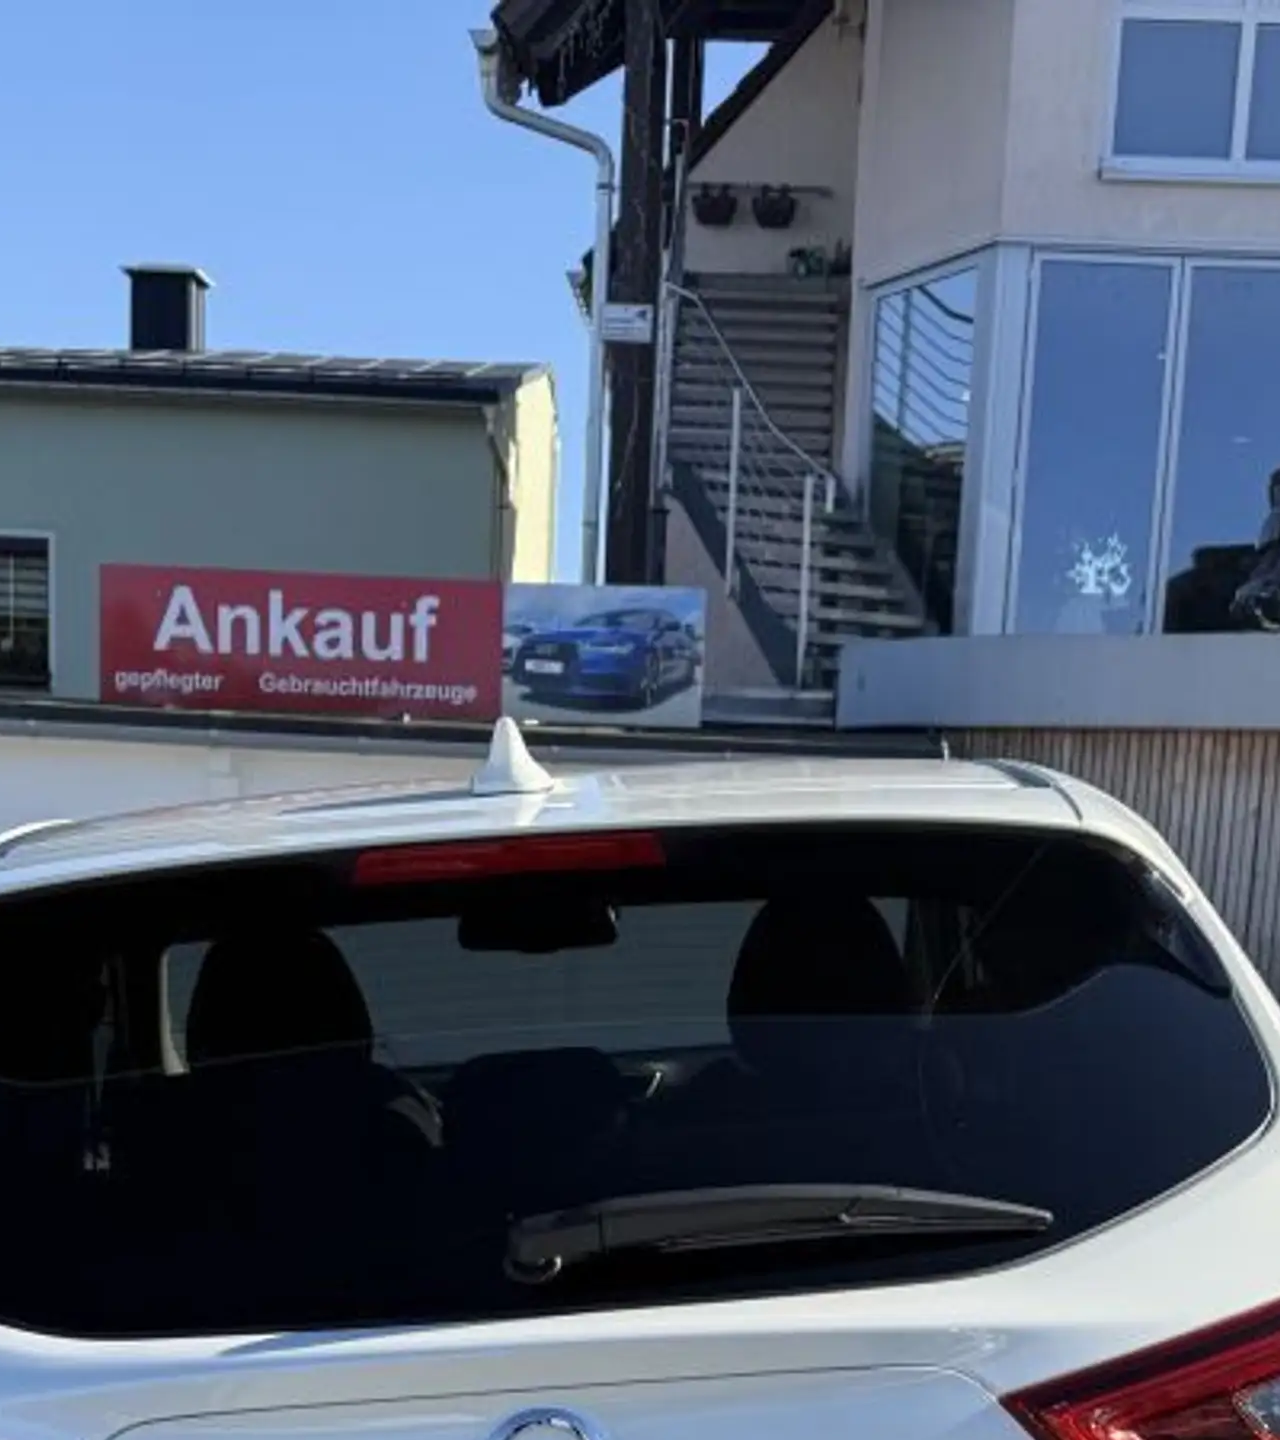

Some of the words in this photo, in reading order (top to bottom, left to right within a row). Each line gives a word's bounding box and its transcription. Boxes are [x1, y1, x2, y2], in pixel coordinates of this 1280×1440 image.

[154, 585, 440, 663] Ankauf
[114, 669, 224, 693] gepflegter
[259, 671, 477, 705] Gebrauchtfahrzeuge
